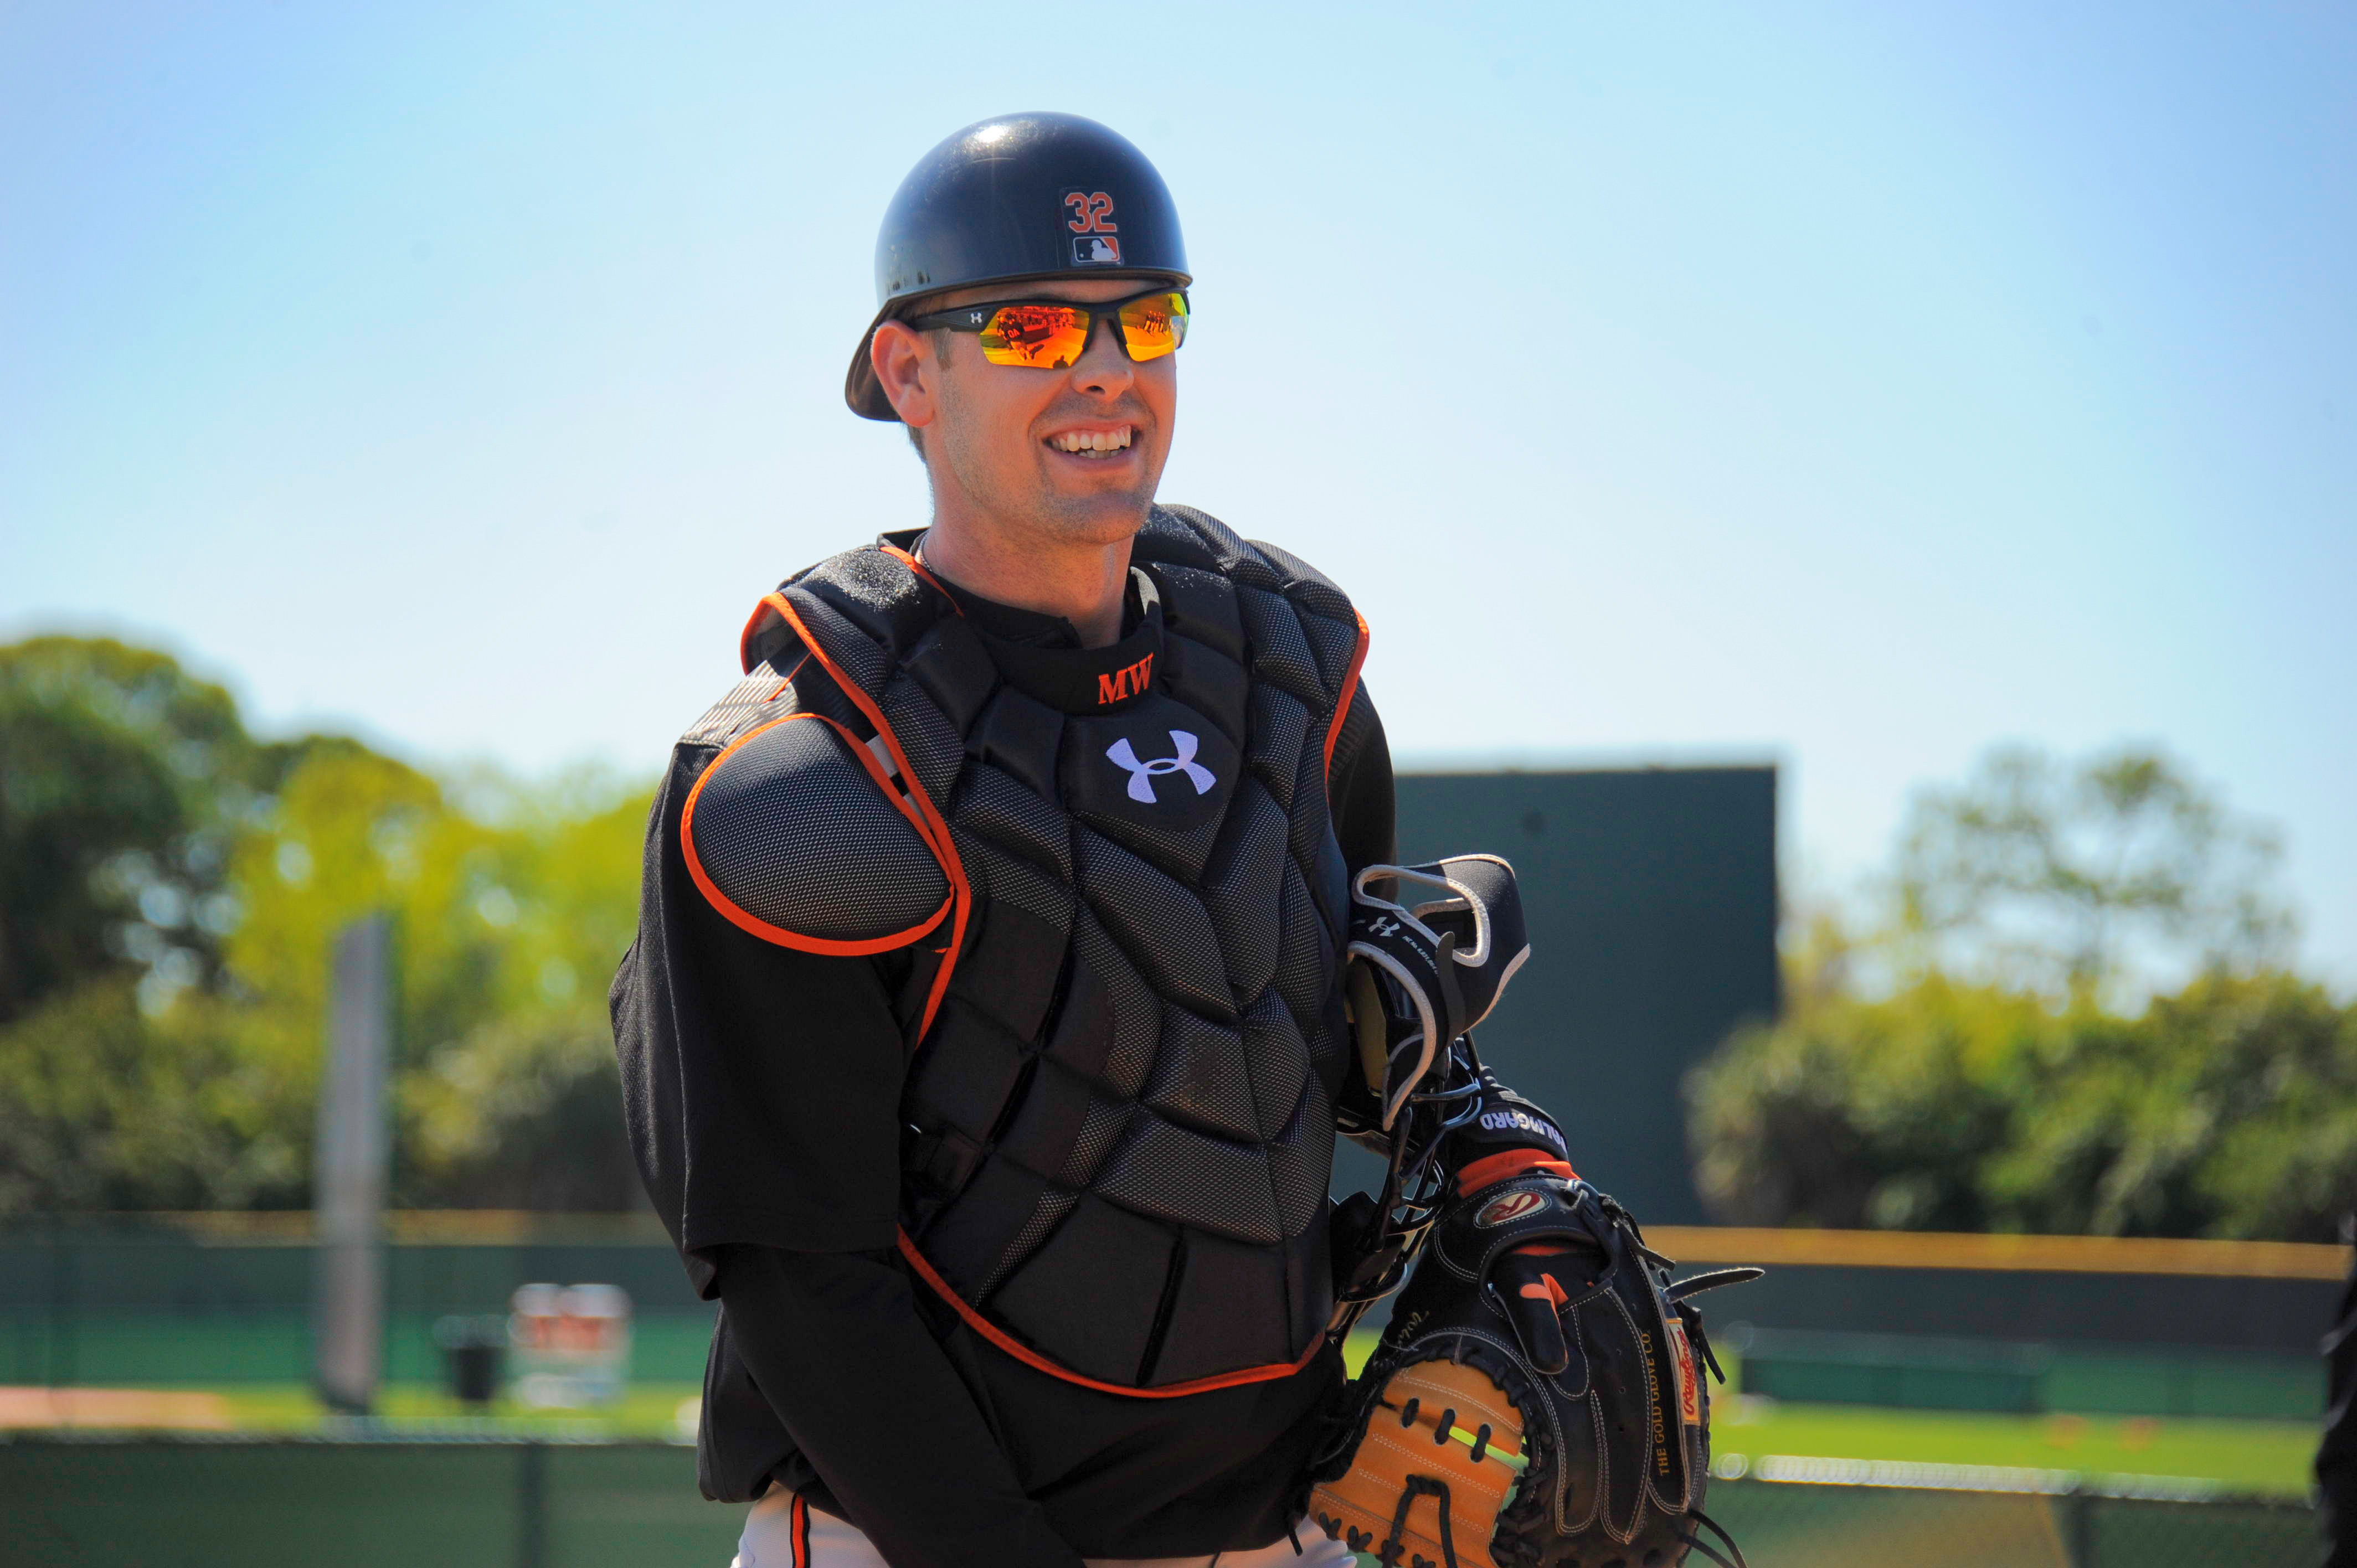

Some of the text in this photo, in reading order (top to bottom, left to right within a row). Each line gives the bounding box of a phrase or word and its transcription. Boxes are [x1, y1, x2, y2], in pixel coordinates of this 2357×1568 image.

[1065, 192, 1117, 233] 32
[1098, 652, 1154, 704] MW
[1480, 1112, 1568, 1154] PALMGARD
[1648, 1358, 1660, 1401] GLOVE
[1677, 1327, 1696, 1415] Rawlings
[1653, 1406, 1664, 1443] GOLD
[1656, 1448, 1670, 1476] THE
